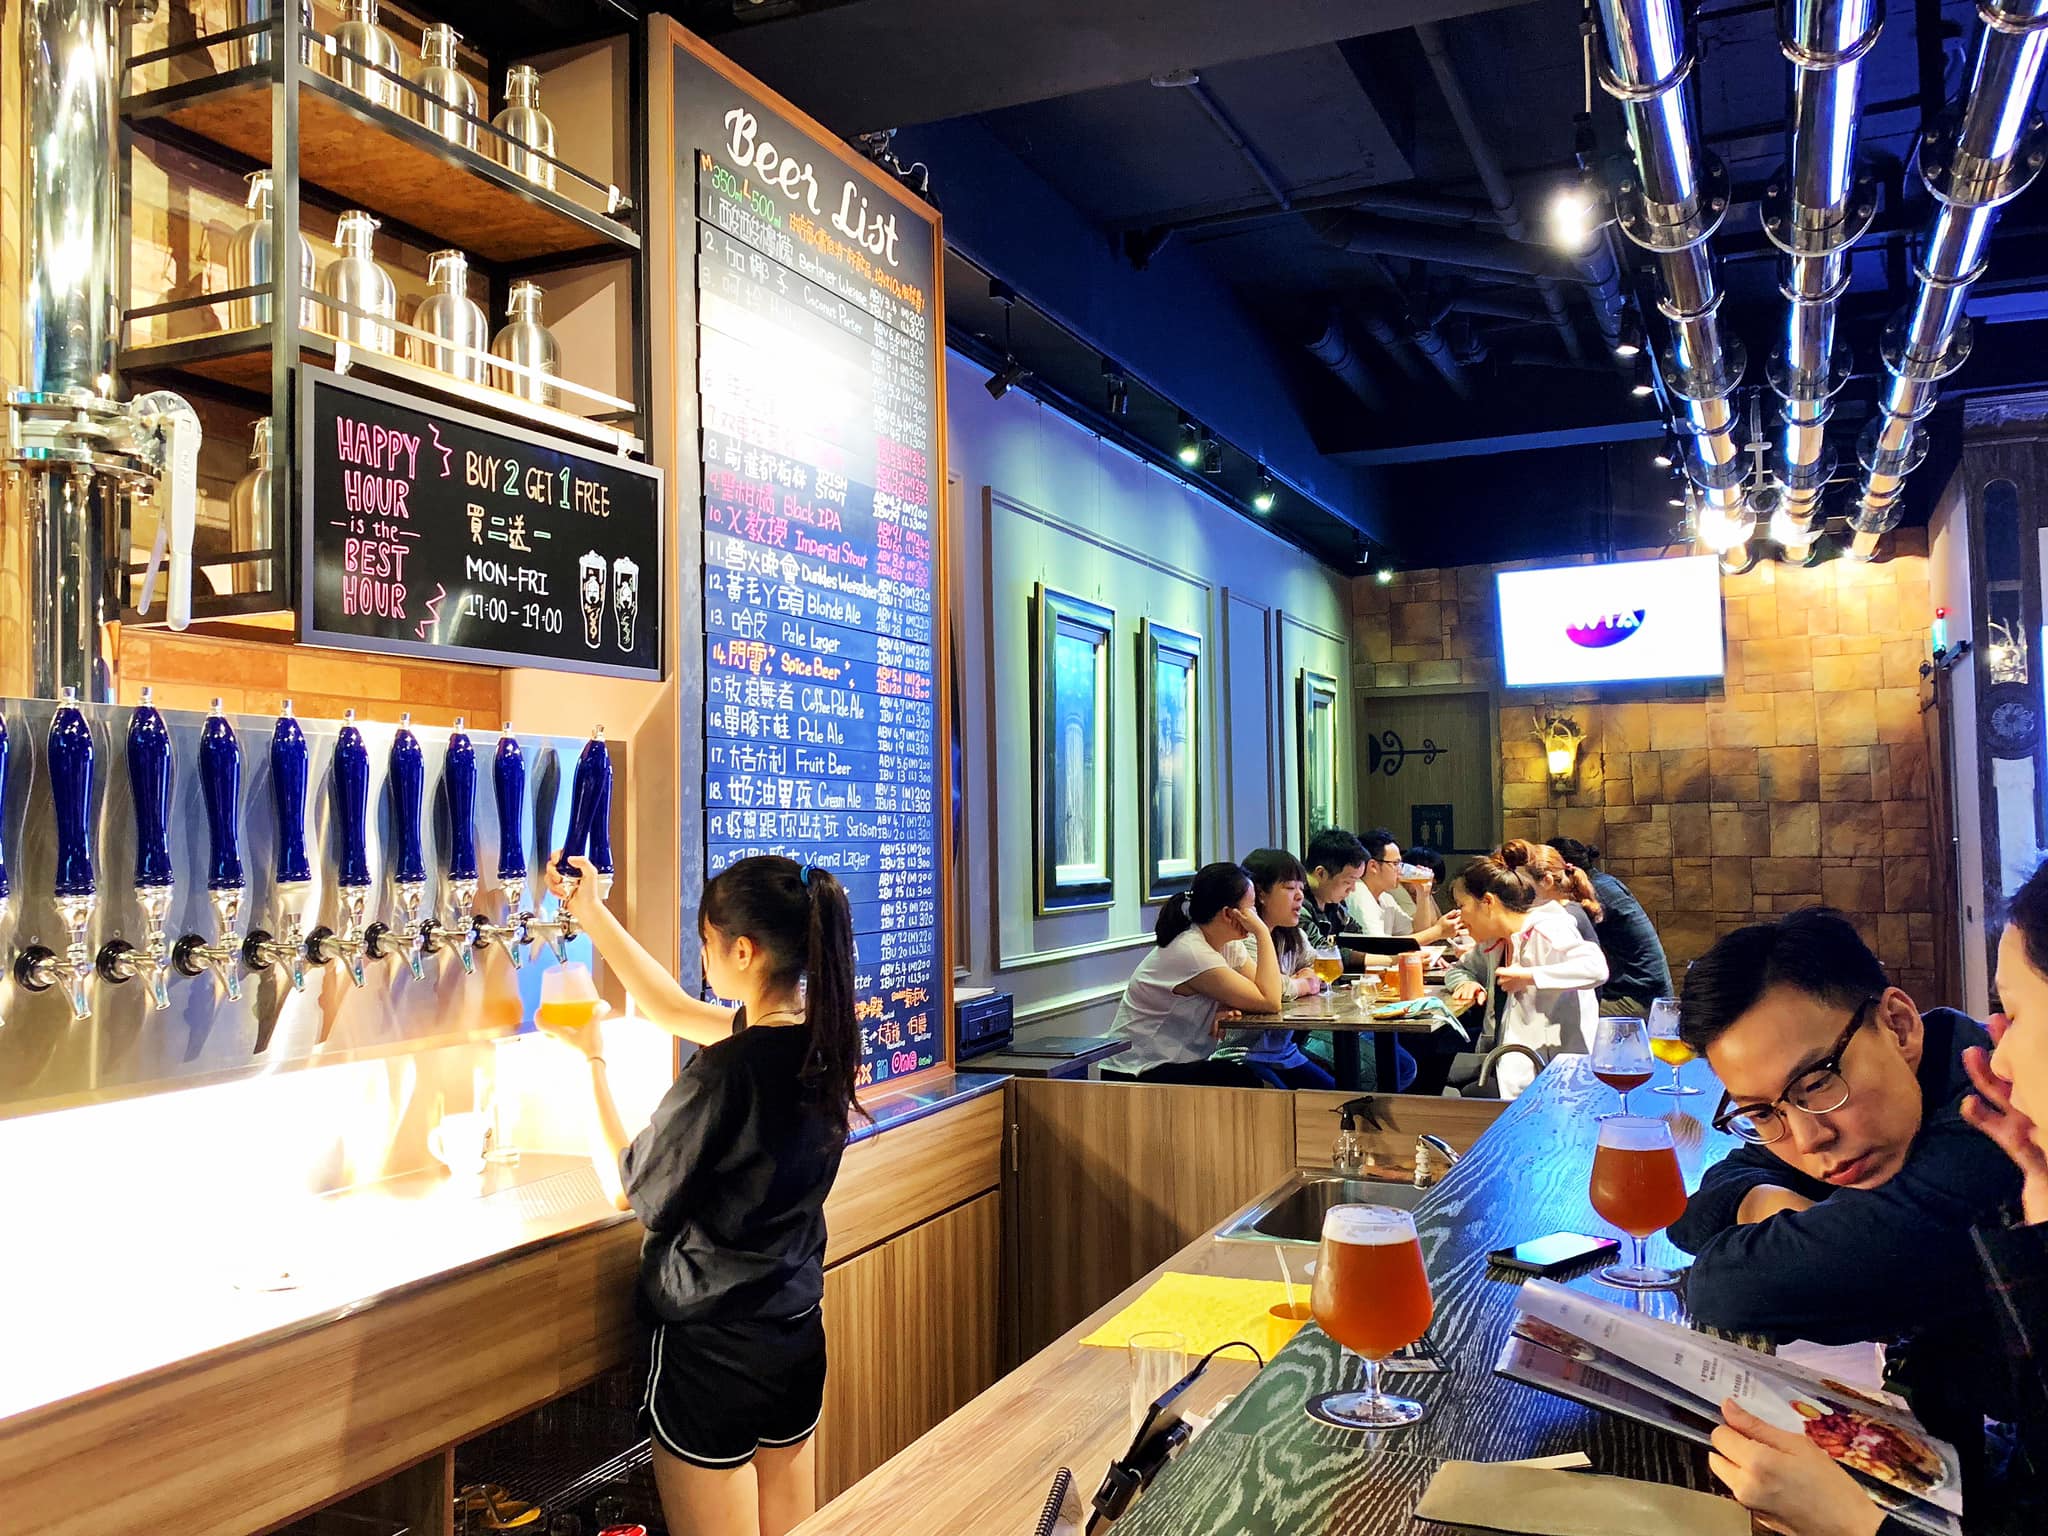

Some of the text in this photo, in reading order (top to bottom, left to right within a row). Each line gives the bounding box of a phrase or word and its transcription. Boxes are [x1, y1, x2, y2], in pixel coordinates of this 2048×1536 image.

[702, 154, 713, 172] M
[743, 178, 752, 199] L
[724, 108, 821, 216] Beer
[831, 181, 898, 267] List
[336, 415, 421, 480] HAPPY
[466, 450, 611, 518] BUY 2 GET 1 FREE
[815, 467, 848, 493] IRISH
[344, 469, 409, 519] HOUR
[815, 484, 847, 507] STOUT
[466, 502, 552, 552] 買二送一
[817, 507, 842, 533] IPA
[350, 515, 399, 542] is the
[795, 530, 840, 564] Imperial
[842, 541, 868, 569] Stout
[344, 538, 410, 582] BEST
[466, 554, 550, 596] MON-FRI
[876, 562, 892, 576] IBU
[342, 575, 407, 619] HOUR
[878, 593, 893, 606] IBU
[807, 591, 844, 620] Blonde
[844, 601, 861, 624] Ale
[876, 606, 892, 620] ABV
[710, 607, 840, 654] 13. 哈皮 Pale Lager
[876, 621, 891, 633] IBU
[877, 636, 894, 651] ABV
[712, 640, 841, 681] 14. 閃電 Spice Beer
[877, 651, 894, 666] IBU
[876, 666, 892, 680] ABV
[876, 680, 891, 694] IBU
[891, 683, 902, 695] 20
[801, 687, 831, 714] Coffee
[831, 688, 850, 717] Pale
[850, 693, 865, 719] Ale
[879, 696, 893, 709] ABV
[879, 709, 894, 723] IBU
[709, 712, 724, 729] 16.
[798, 716, 823, 744] Pale
[827, 722, 844, 745] Ale
[877, 725, 893, 739] ABV
[877, 740, 893, 752] IBU
[895, 741, 904, 754] 19
[711, 744, 852, 776] 17. 大吉大利 Fruit Beer
[879, 753, 908, 770] ABV 5.6
[879, 769, 905, 783] IBU 13
[709, 781, 723, 800] 18.
[818, 781, 845, 808] Cream
[847, 783, 862, 808] Ale
[875, 783, 888, 796] ABV
[890, 785, 896, 797] 5
[875, 797, 889, 810] IBU
[726, 811, 839, 841] 好想跟你出去玩
[847, 815, 877, 837] Saison
[877, 814, 892, 827] ABV
[877, 827, 892, 839] IBU
[893, 829, 905, 839] 20
[880, 843, 895, 856] ABV
[895, 843, 906, 855] 5.5
[804, 851, 840, 868] Vienna
[843, 849, 871, 871] Lager
[880, 857, 895, 870] IBU
[878, 873, 895, 887] ABV
[878, 887, 893, 900] IBU
[880, 901, 908, 916] ABV 8.5
[880, 917, 895, 930] IBU
[881, 933, 897, 946] ABV
[881, 946, 908, 961] IBU 20
[880, 963, 895, 976] ABV
[895, 961, 907, 975] 5.4
[880, 976, 895, 990] IBU
[896, 975, 906, 988] 27
[891, 1050, 917, 1074] One
